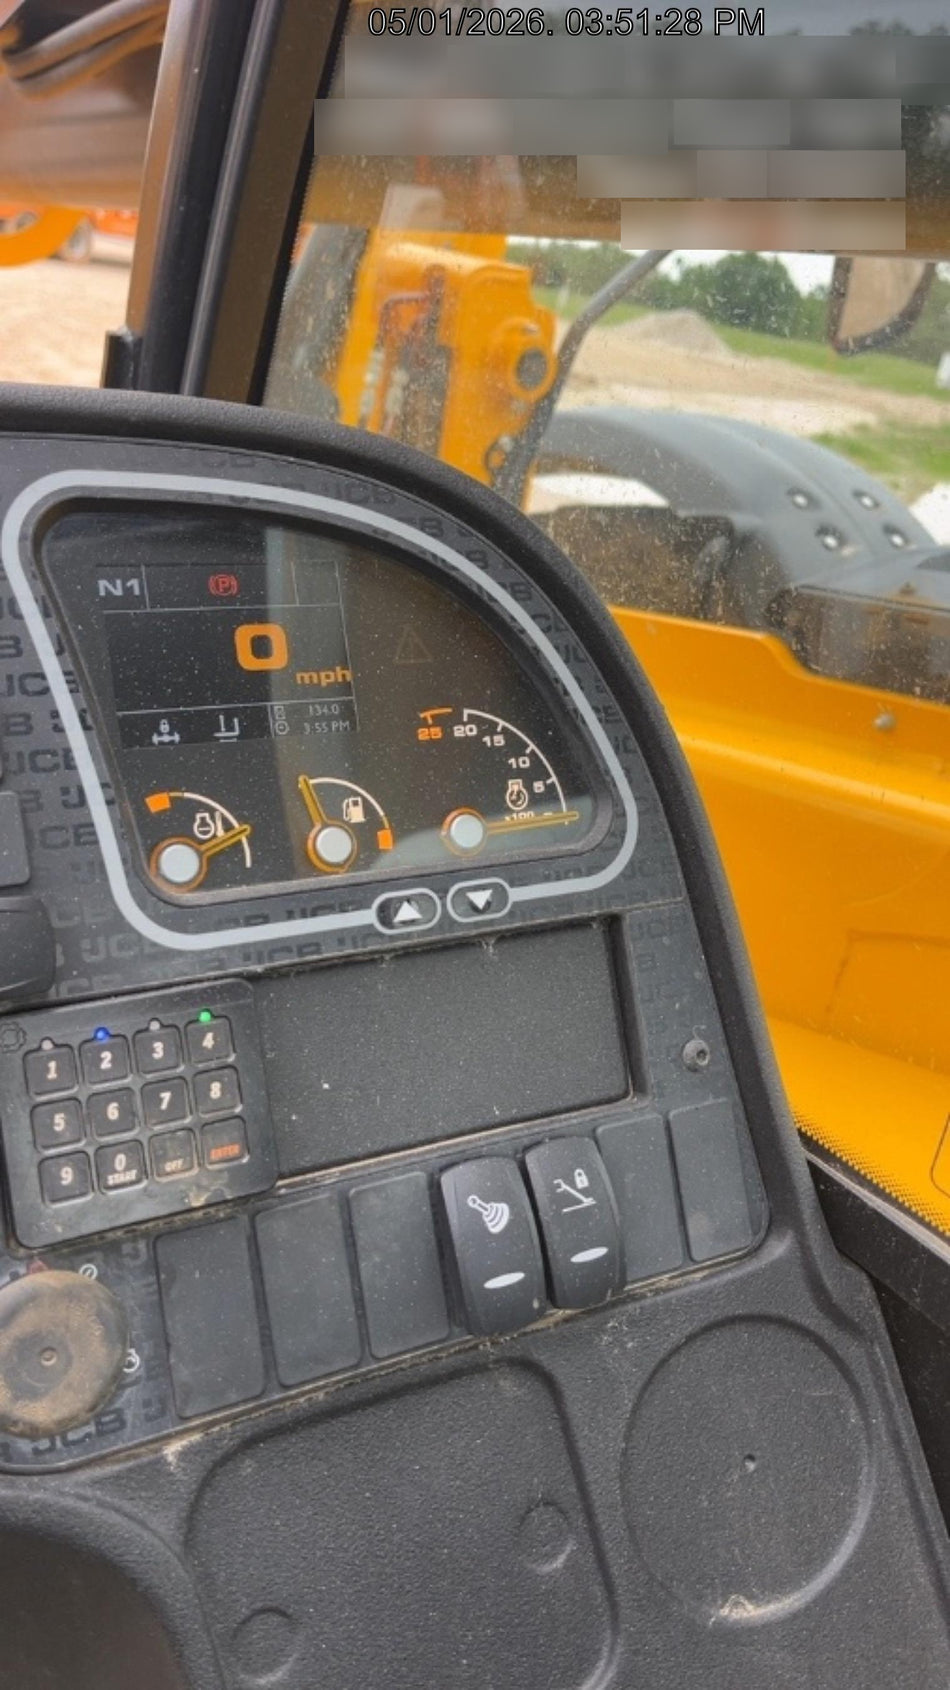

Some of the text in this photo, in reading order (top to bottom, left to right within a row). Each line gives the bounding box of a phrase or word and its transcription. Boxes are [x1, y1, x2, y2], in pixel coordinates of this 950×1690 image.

[98, 578, 141, 597] N1
[234, 622, 289, 672] 0
[295, 666, 353, 687] mph
[331, 720, 350, 732] PM
[416, 725, 443, 741] 25
[453, 724, 478, 738] 20
[482, 734, 506, 748] 15
[508, 756, 530, 769] 10
[532, 780, 545, 794] 5
[202, 1031, 215, 1049] 4
[152, 1041, 164, 1060] 3
[100, 1051, 112, 1069] 2
[46, 1060, 58, 1080] 1
[209, 1081, 222, 1099] 8
[159, 1091, 172, 1110] 7
[106, 1102, 119, 1120] 6
[53, 1113, 65, 1131] 5
[114, 1153, 126, 1172] 0
[165, 1158, 184, 1173] OFF
[60, 1166, 74, 1185] 9
